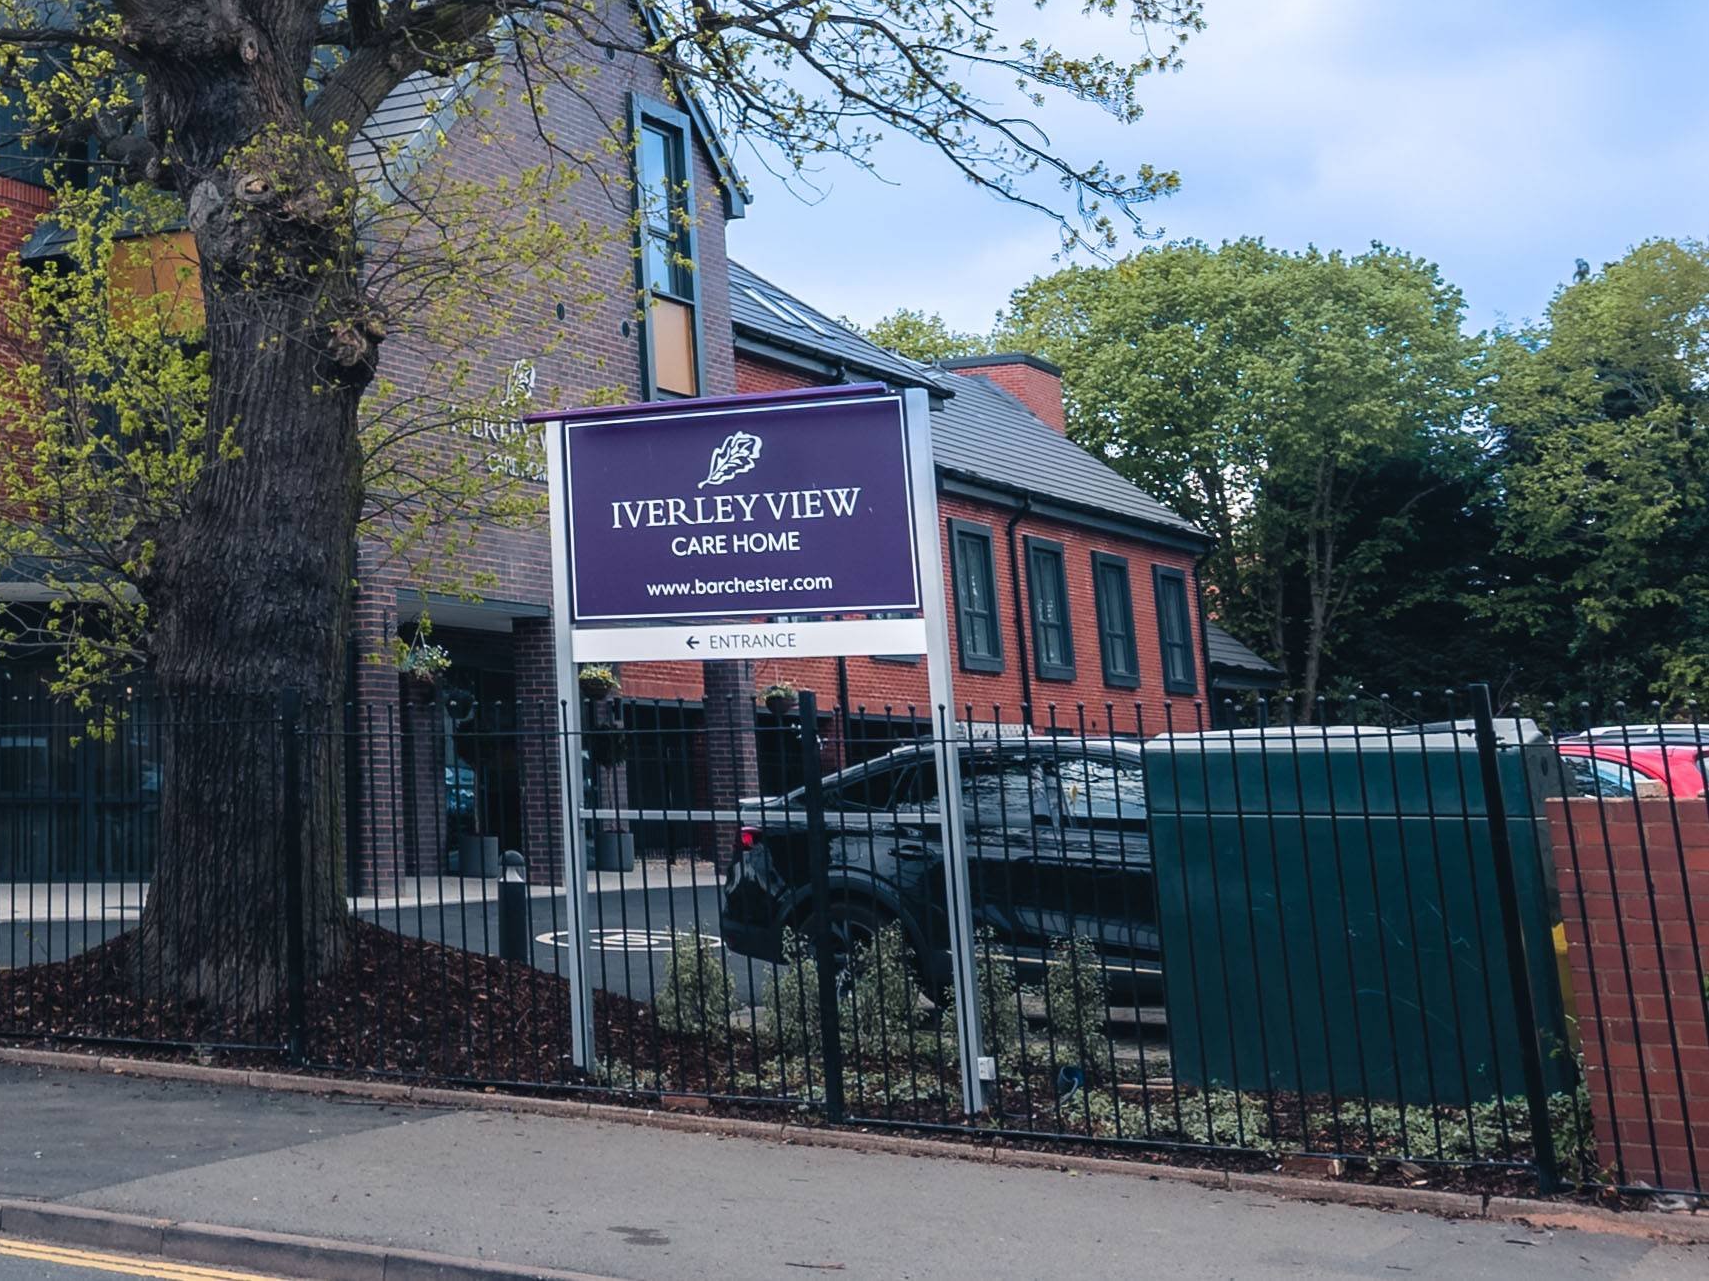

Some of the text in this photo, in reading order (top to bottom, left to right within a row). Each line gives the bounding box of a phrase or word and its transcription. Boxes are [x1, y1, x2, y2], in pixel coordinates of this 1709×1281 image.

[611, 487, 861, 529] IVERLEY VIEW
[671, 531, 801, 556] CARE HOME
[647, 576, 833, 596] www.barchester.com
[709, 633, 797, 650] ENTRANCE
